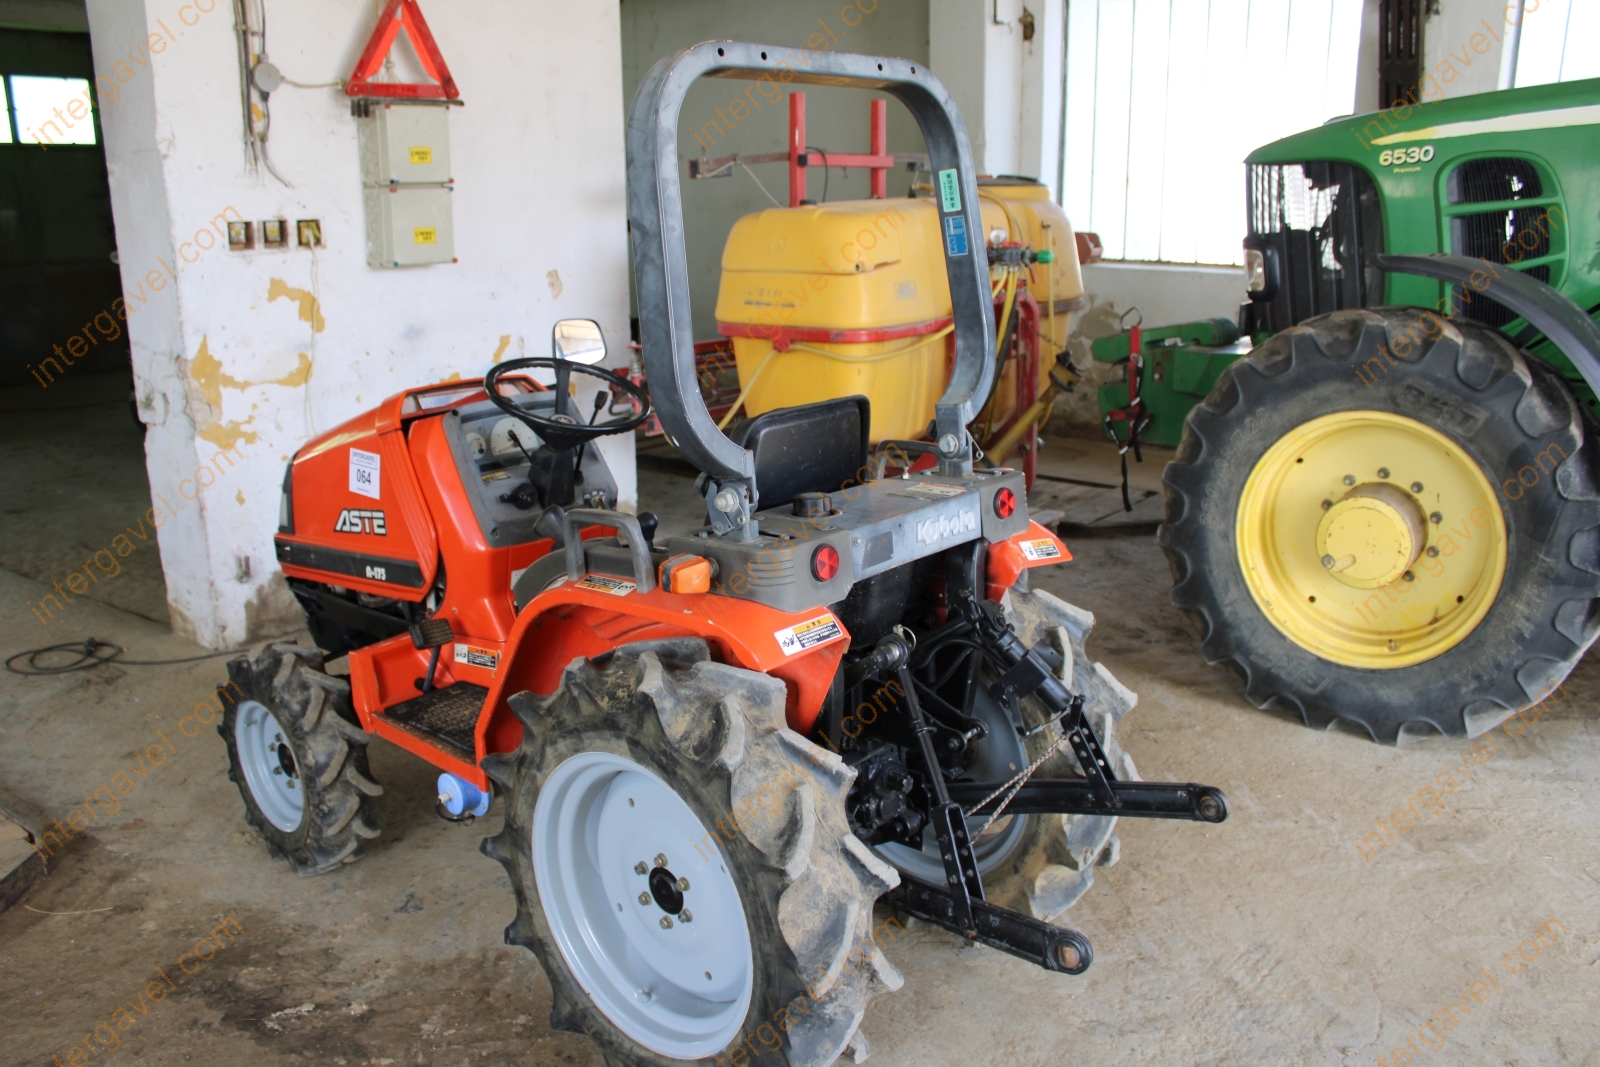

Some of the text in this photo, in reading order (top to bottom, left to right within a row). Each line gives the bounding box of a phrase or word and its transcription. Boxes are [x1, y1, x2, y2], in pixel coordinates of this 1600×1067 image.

[1378, 144, 1435, 168] 6530
[1393, 166, 1421, 175] Premium
[356, 468, 372, 486] 064
[333, 508, 387, 536] ASTE
[916, 507, 976, 546] Kubota
